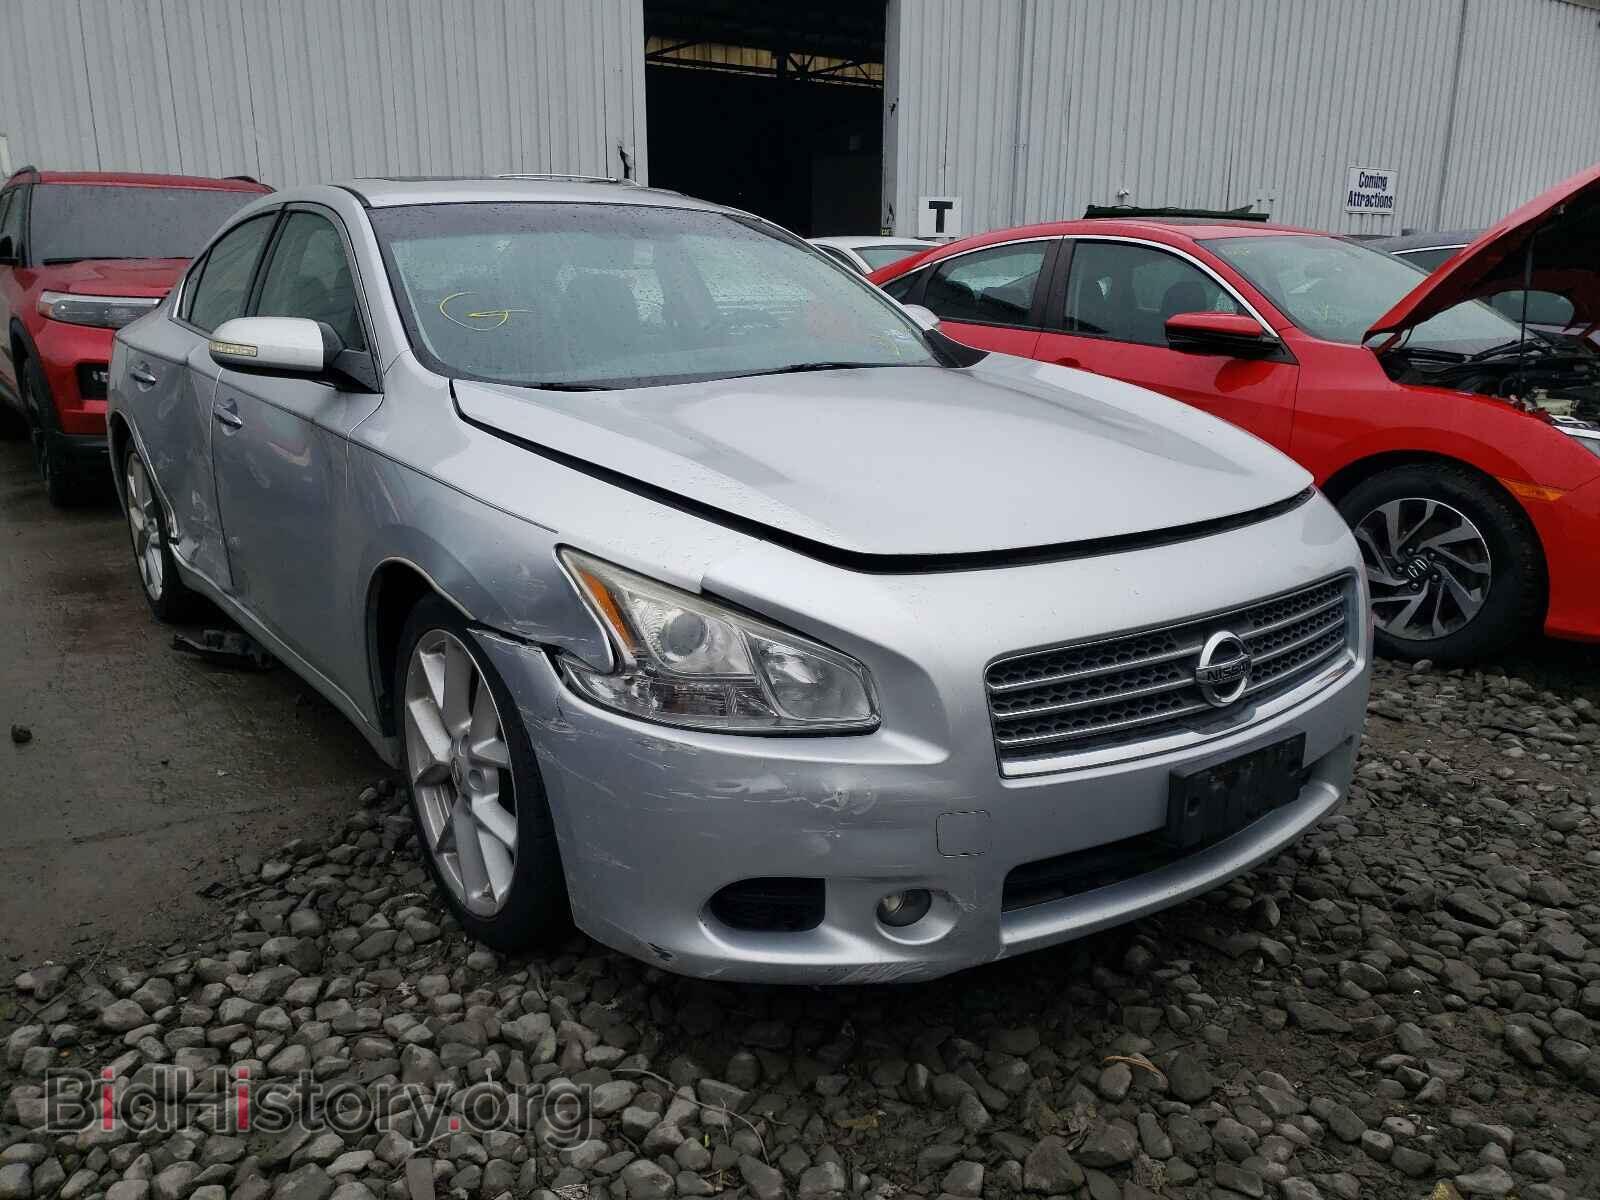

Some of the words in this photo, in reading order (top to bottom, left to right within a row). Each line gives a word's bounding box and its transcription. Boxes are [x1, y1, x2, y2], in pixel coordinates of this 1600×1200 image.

[1359, 171, 1388, 191] Coming
[1347, 190, 1393, 208] Attractions
[928, 201, 954, 234] T
